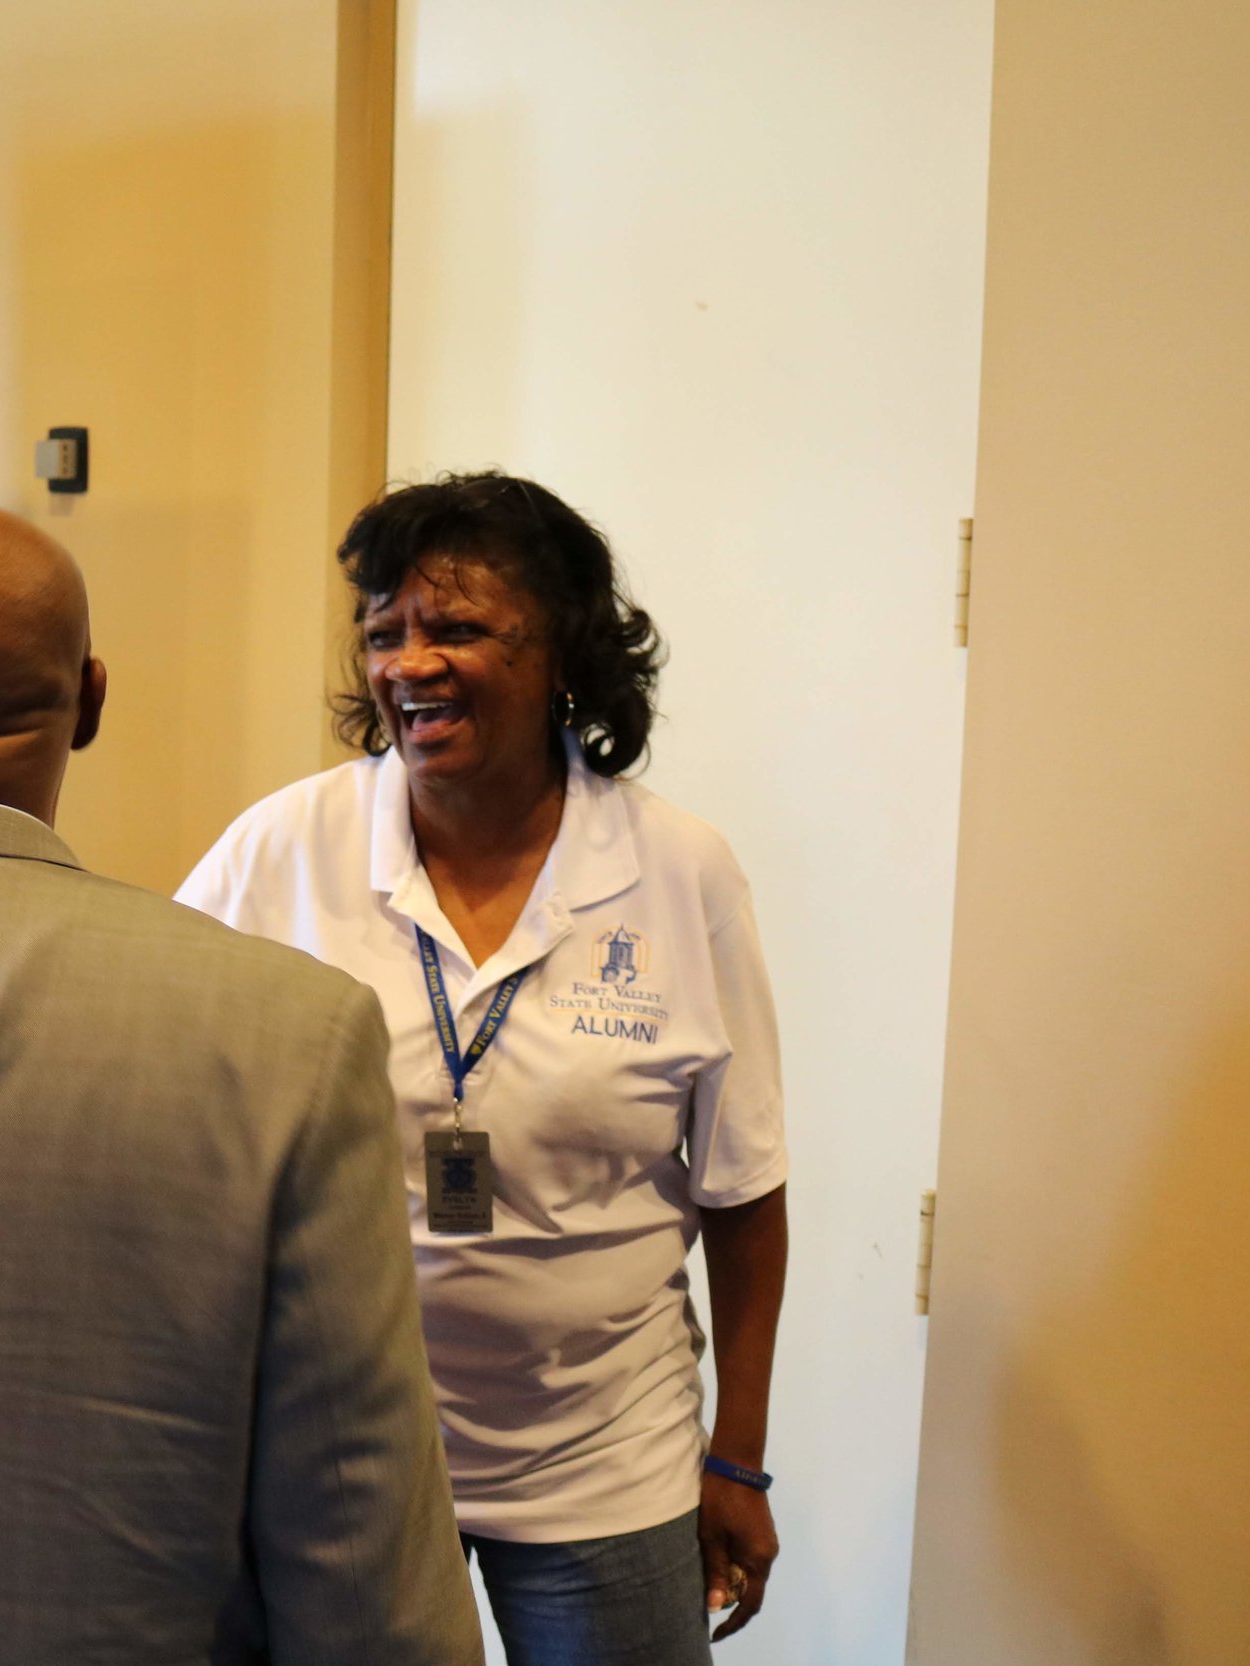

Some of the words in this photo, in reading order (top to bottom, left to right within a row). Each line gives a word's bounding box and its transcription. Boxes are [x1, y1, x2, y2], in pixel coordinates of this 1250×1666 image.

[490, 986, 515, 1019] VALLEY
[549, 995, 592, 1009] STATE
[572, 982, 608, 997] FORT
[614, 985, 663, 1004] VALLEY
[571, 1015, 659, 1045] ALUMNI
